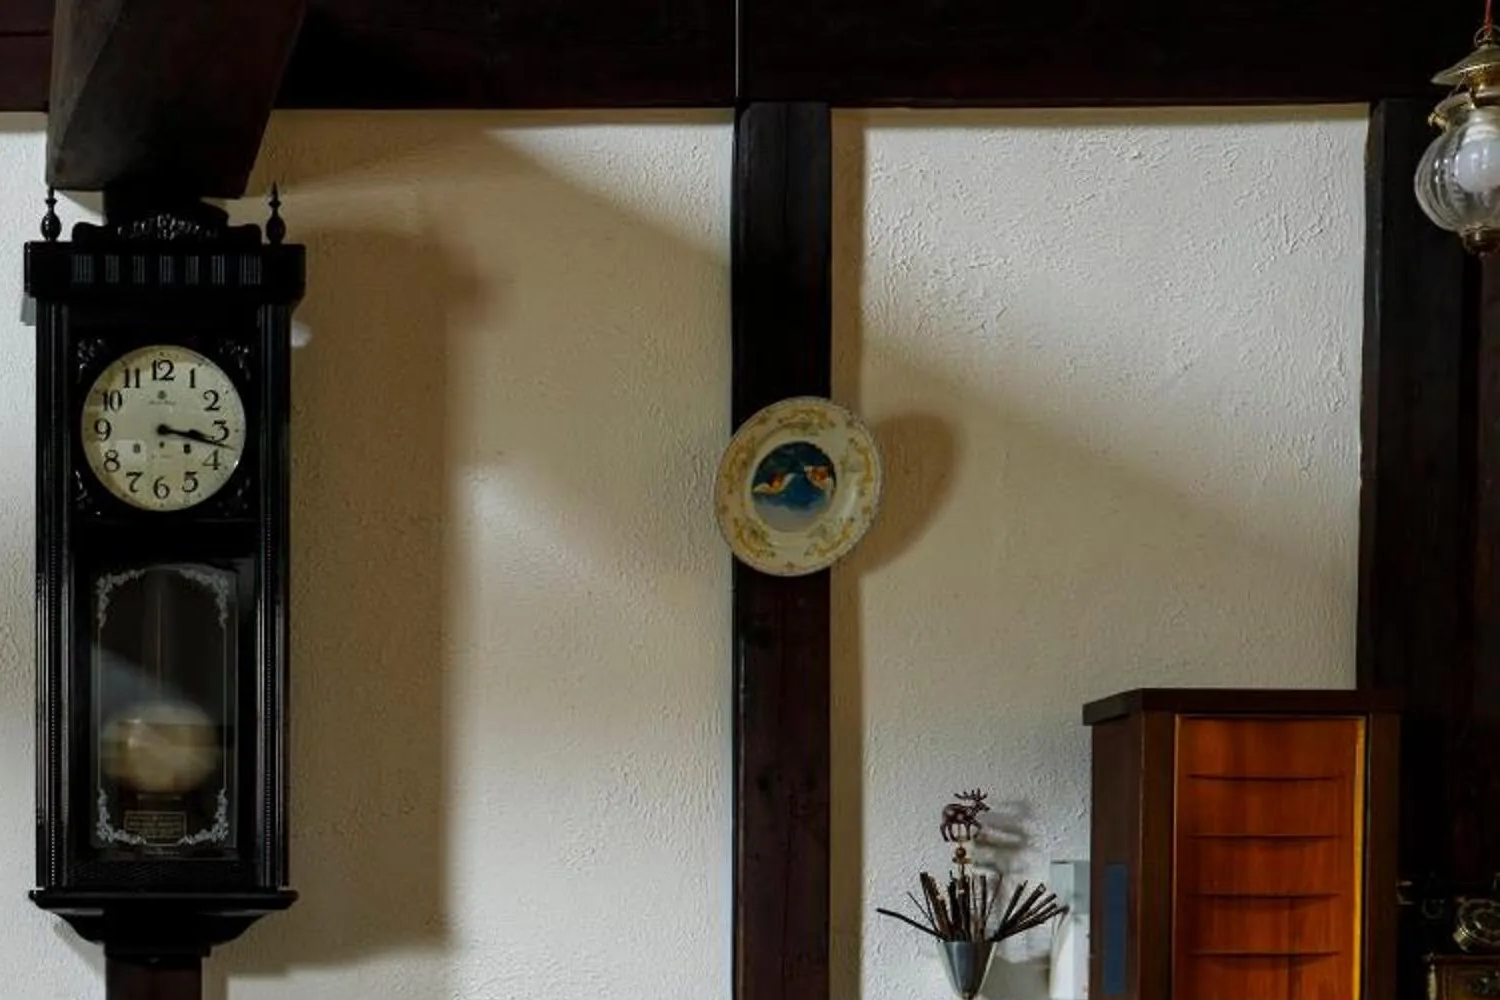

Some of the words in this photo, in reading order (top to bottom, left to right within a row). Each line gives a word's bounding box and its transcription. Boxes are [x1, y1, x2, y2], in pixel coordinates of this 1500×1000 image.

[124, 368, 141, 388] 11
[152, 359, 176, 381] 12
[189, 368, 196, 388] 1
[103, 390, 123, 412] 10
[203, 389, 221, 411] 2
[94, 419, 112, 441] 9
[212, 420, 229, 442] 3
[103, 450, 120, 472] 8
[202, 450, 221, 470] 4
[126, 471, 143, 493] 7
[153, 476, 170, 499] 6
[182, 471, 198, 493] 5
